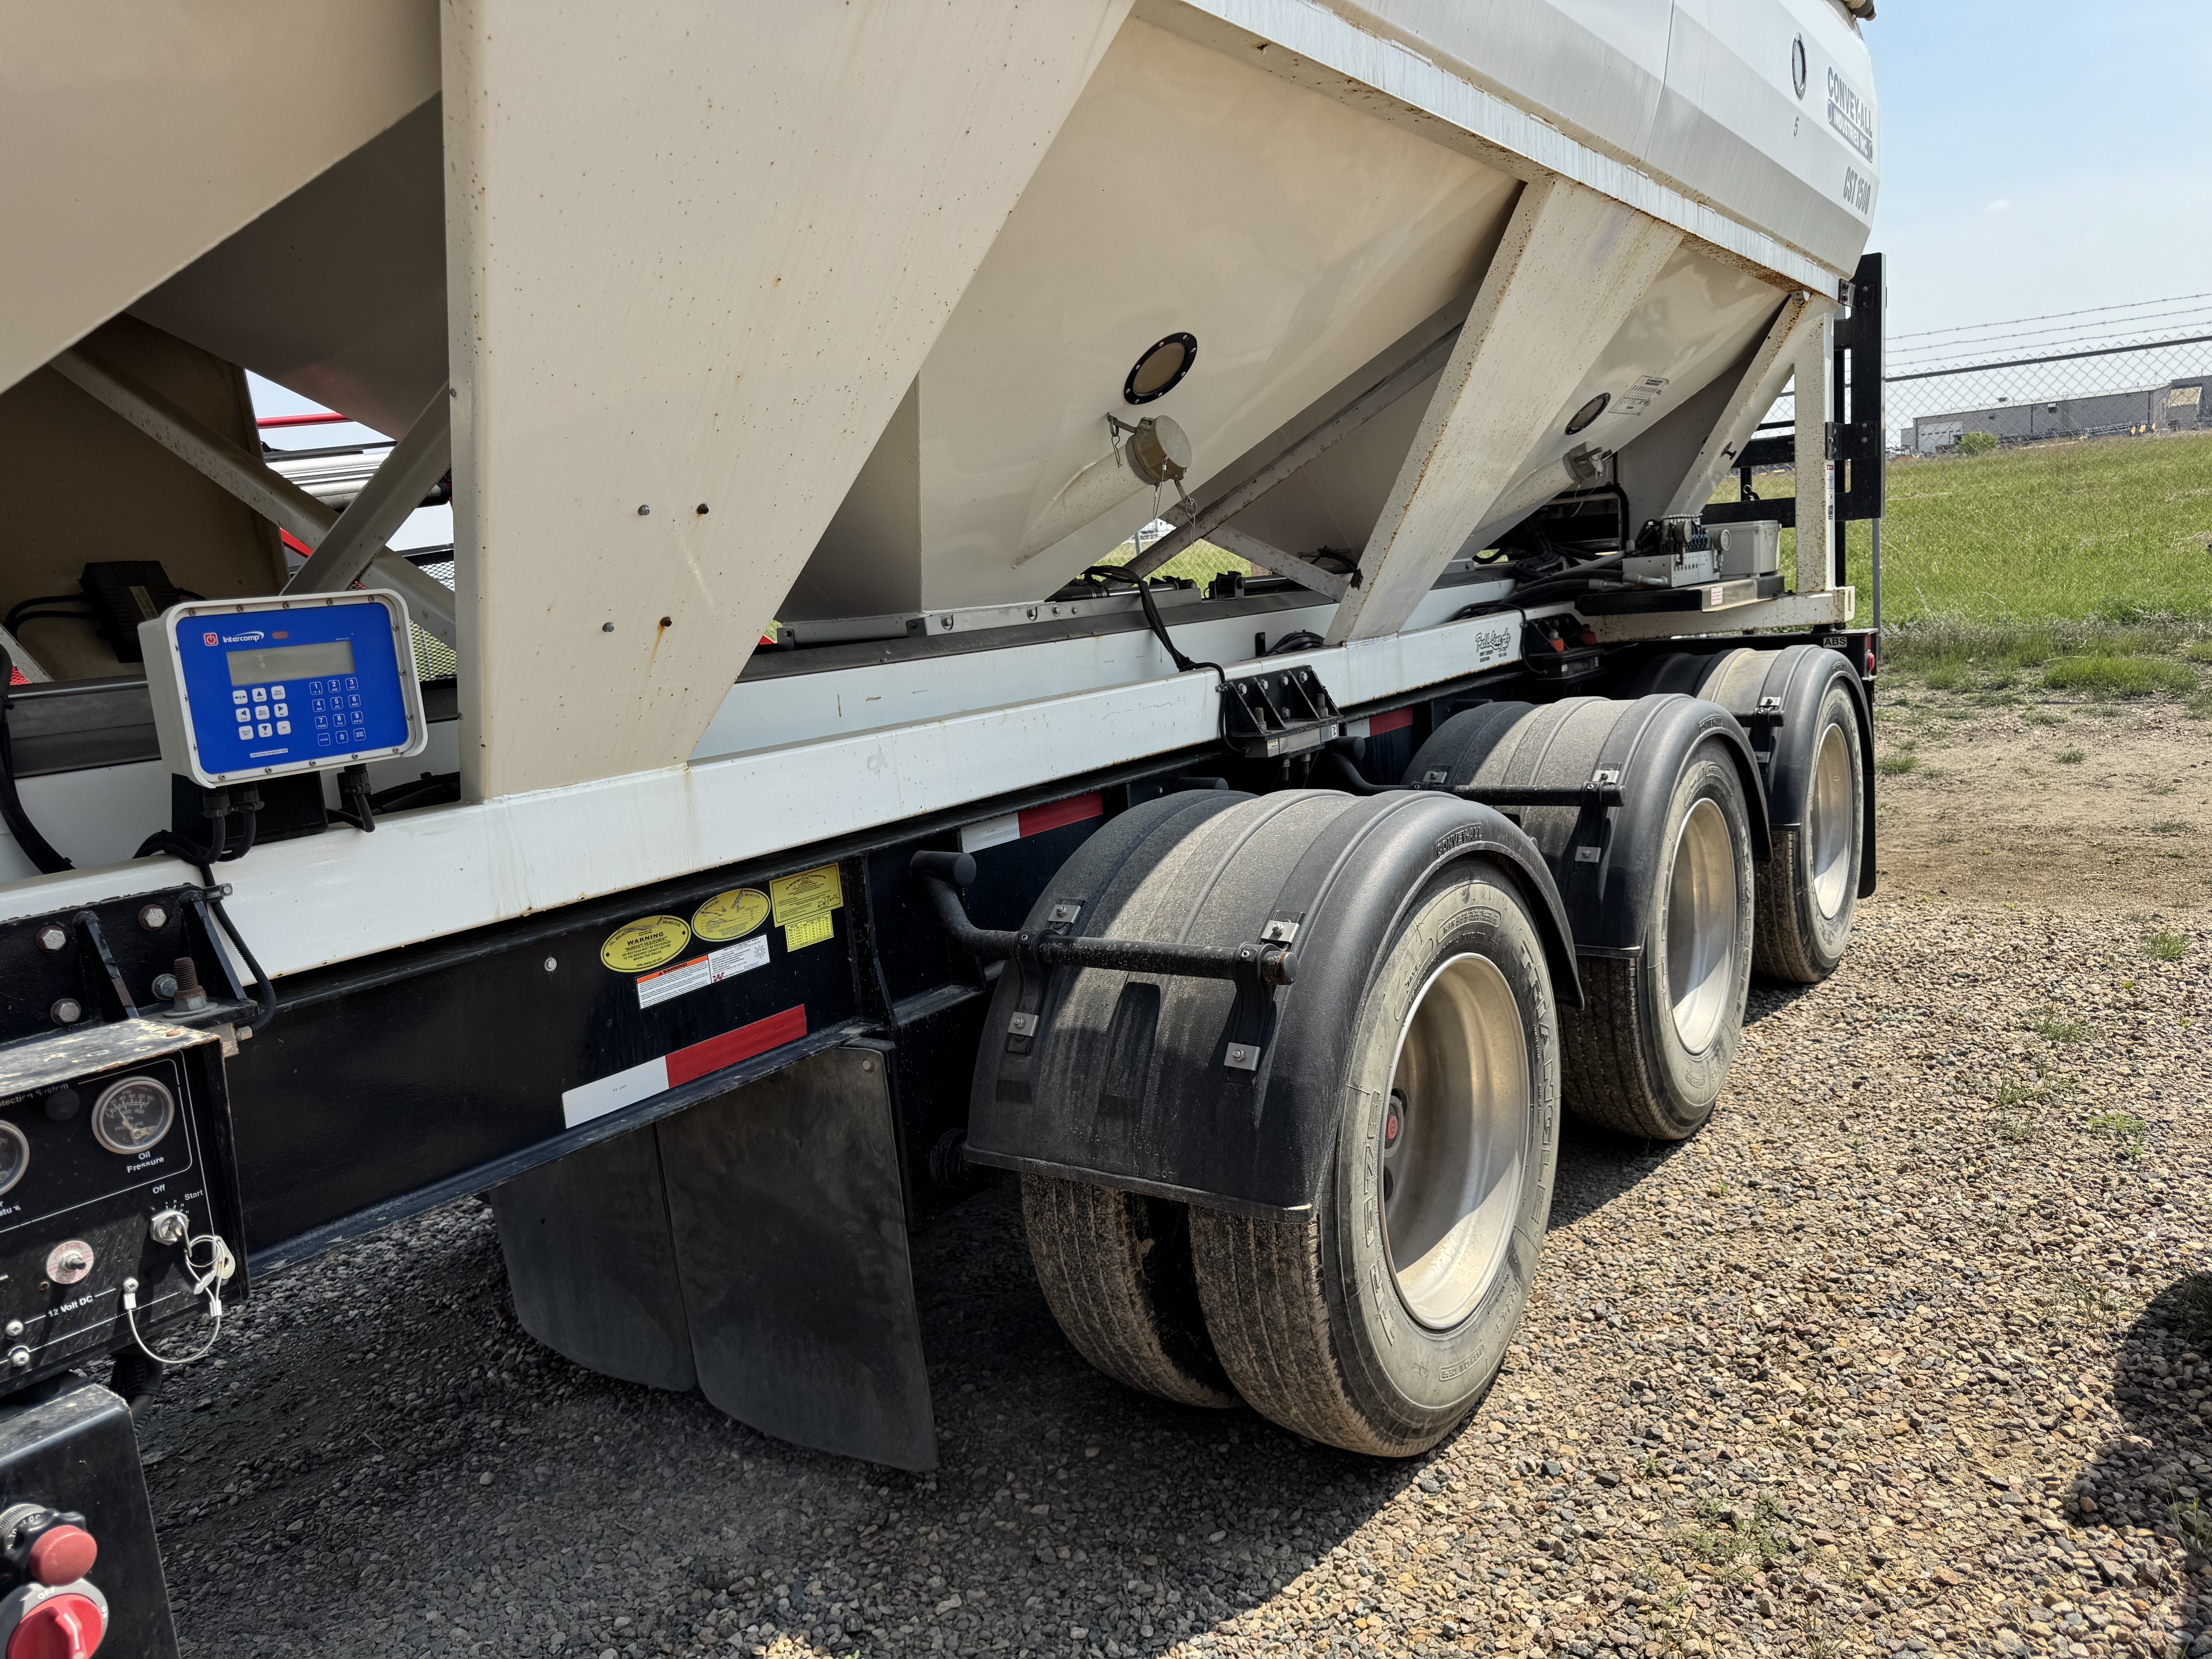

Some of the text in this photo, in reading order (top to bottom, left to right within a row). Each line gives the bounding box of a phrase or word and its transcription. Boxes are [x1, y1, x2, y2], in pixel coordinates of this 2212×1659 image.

[1827, 66, 1872, 139] CONVEY-ALL
[1793, 116, 1799, 137] 5
[1833, 108, 1868, 156] INDUSTRIES INC.
[1843, 166, 1871, 214] CST 1500
[223, 635, 259, 643] Intercomp
[1824, 637, 1846, 646] ABS
[627, 932, 664, 946] WARNING
[663, 963, 688, 974] WARNING!
[1520, 940, 1554, 1224] TRIANGLE
[138, 1151, 151, 1160] Oil
[127, 1157, 164, 1173] Pressure
[153, 1184, 165, 1194] Off
[184, 1190, 203, 1200] Start
[48, 1295, 93, 1317] 12 Volt DC
[38, 1587, 56, 1600] OFF
